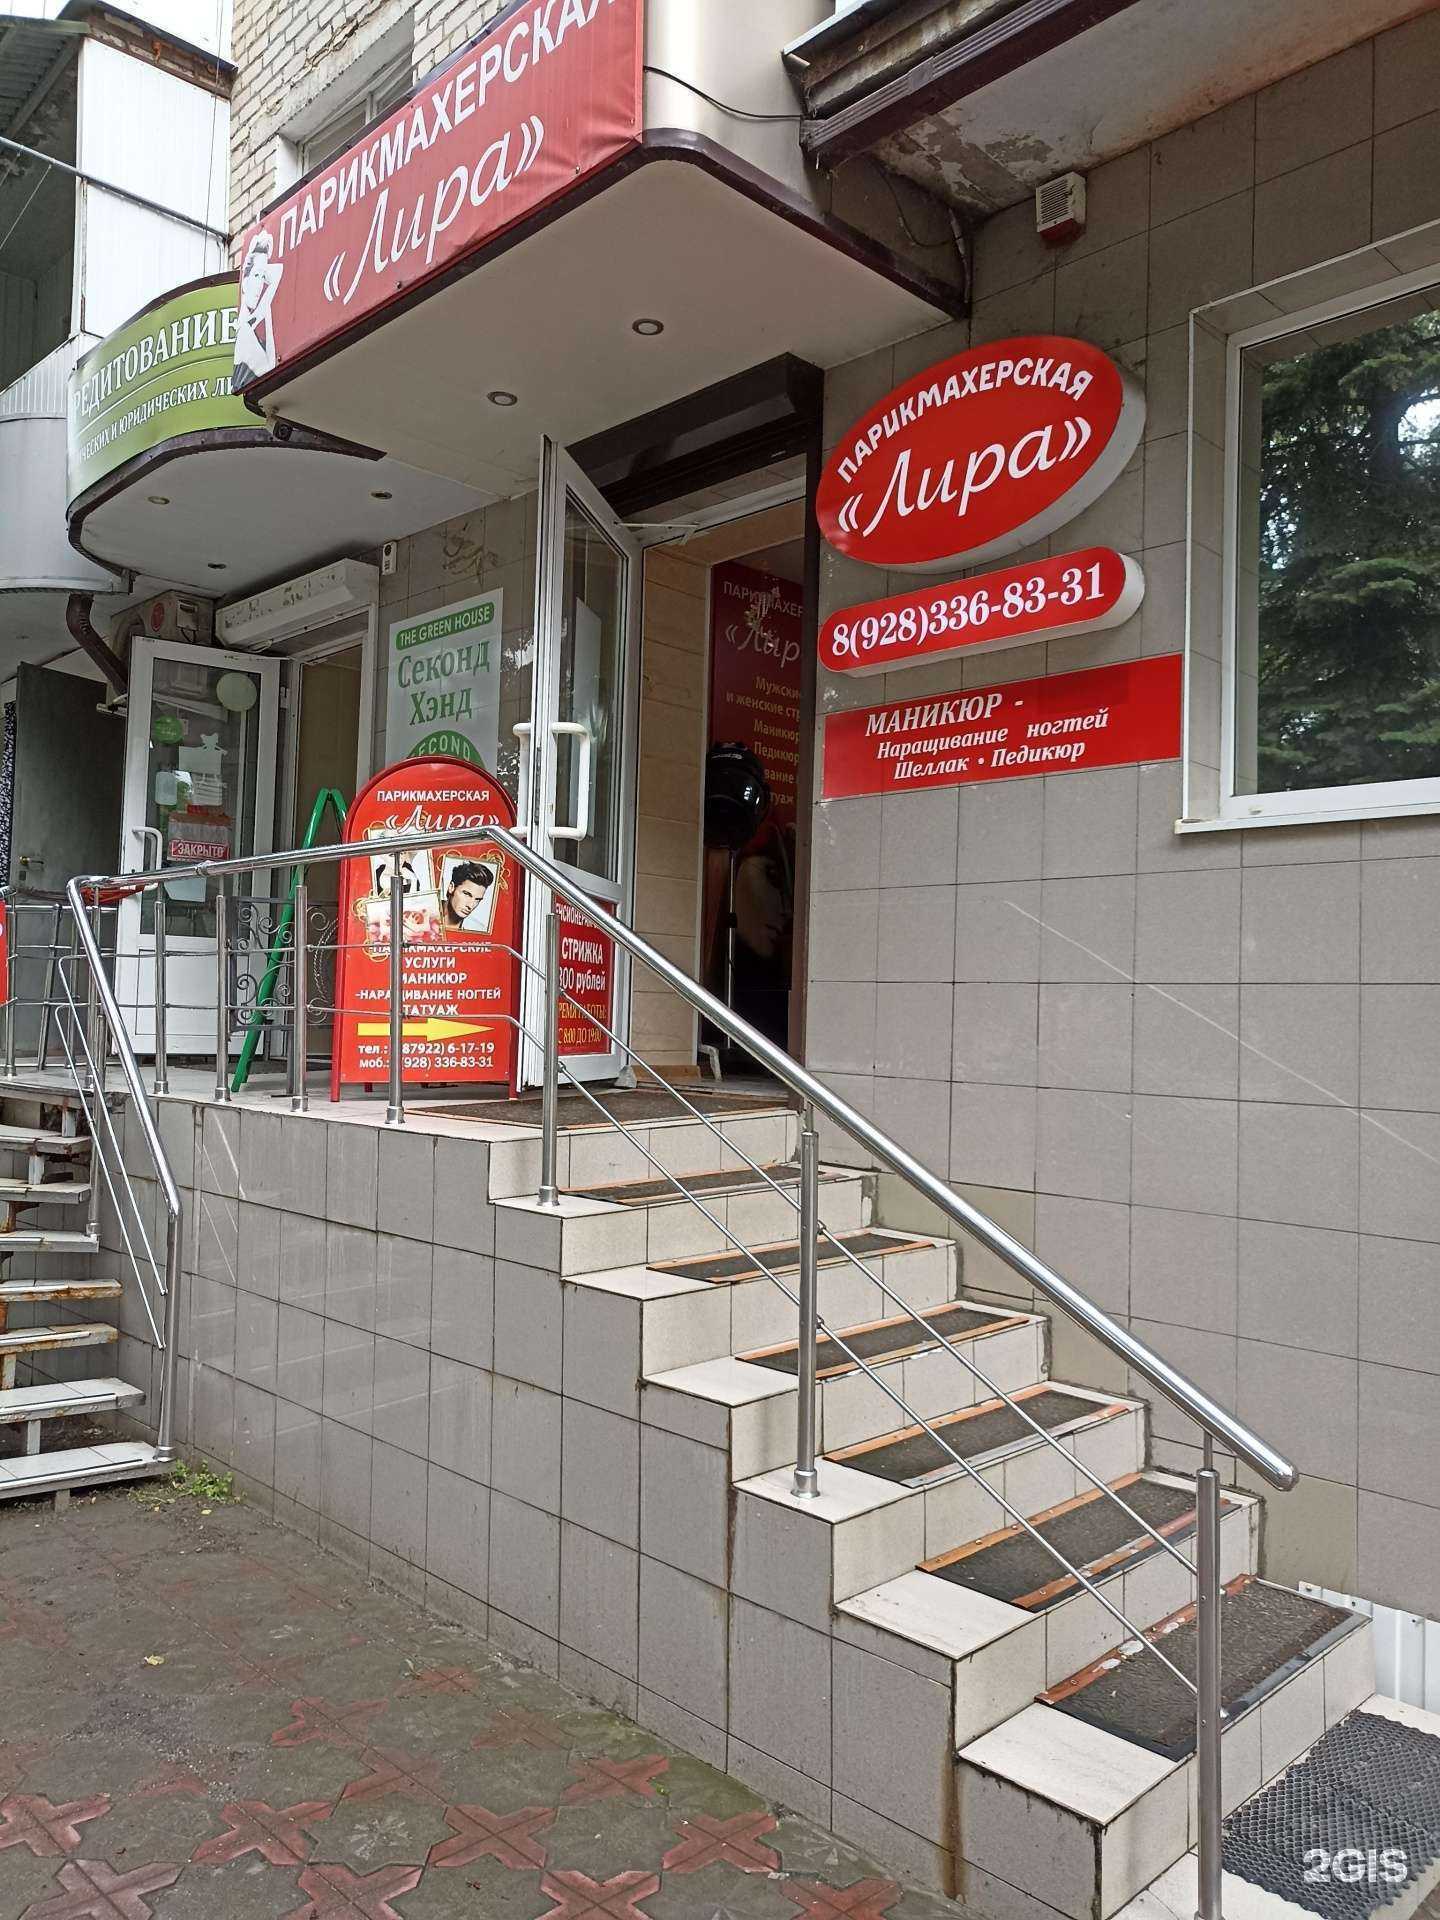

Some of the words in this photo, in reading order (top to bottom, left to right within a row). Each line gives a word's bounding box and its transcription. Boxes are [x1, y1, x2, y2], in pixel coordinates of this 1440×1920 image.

[278, 0, 616, 258] ПАРИКМАХЕРСКА
[323, 115, 545, 306] «Лира»
[72, 307, 240, 418] РЕДИТОВАНИЕ
[79, 427, 110, 463] ЧЕСКИХ
[111, 422, 118, 440] И
[119, 380, 209, 434] ЮРИДИЧЕСКИХ
[837, 357, 1094, 484] ПАРИКМАХЕРСКАЯ
[838, 416, 1092, 537] «Лира»
[400, 632, 417, 647] THE
[419, 618, 451, 641] GREEN
[454, 606, 491, 629] HOUSE
[832, 562, 1106, 659] 8(928)336-83-31
[398, 640, 491, 689] Секонд
[409, 687, 472, 726] Хэнд
[865, 693, 1003, 738] МАНИКЮР
[411, 734, 471, 761] ECOND
[877, 727, 1009, 760] Наращивание
[1027, 708, 1109, 739] ногтей
[893, 756, 969, 781] Шеллак
[991, 740, 1086, 771] Педикюр
[376, 790, 490, 802] ПАРИКМАХЕРСКАЯ
[770, 792, 794, 806] туаж
[177, 841, 225, 858] ЗАКРЫТО
[404, 956, 456, 969] УСЛУГИ
[561, 936, 603, 965] СТРИЖКА
[457, 985, 501, 1000] НОГТЕЙ
[576, 969, 606, 995] рублей
[402, 1004, 459, 1016] ТАТУАЖ
[559, 1002, 576, 1019] РЕМЯ
[402, 1042, 444, 1055] 87922)
[447, 1042, 495, 1055] 6-17-19
[436, 1056, 494, 1068] 336-83-31
